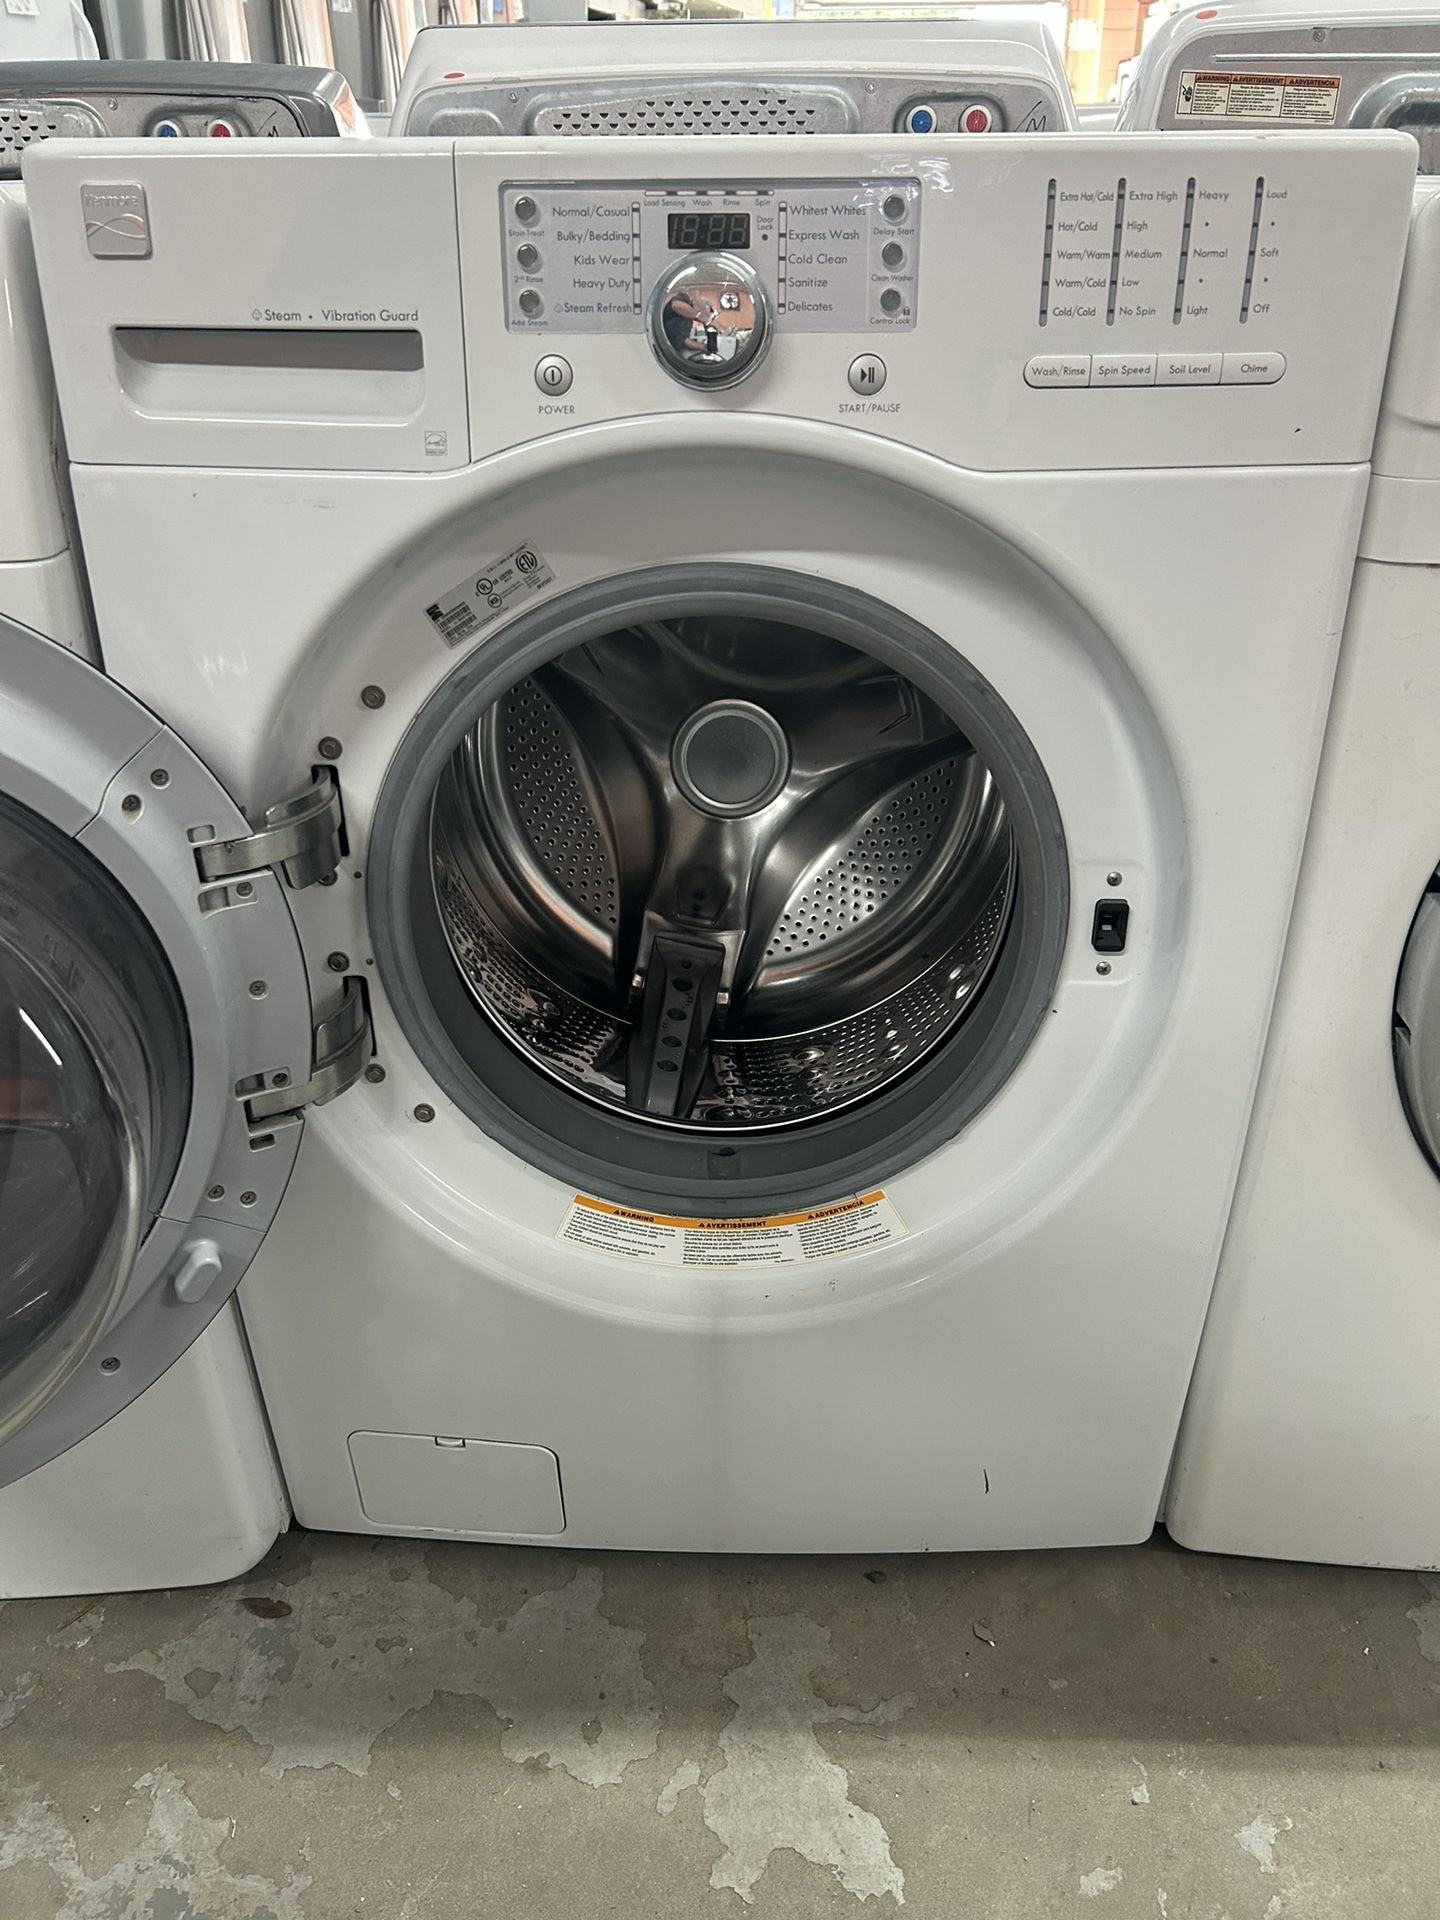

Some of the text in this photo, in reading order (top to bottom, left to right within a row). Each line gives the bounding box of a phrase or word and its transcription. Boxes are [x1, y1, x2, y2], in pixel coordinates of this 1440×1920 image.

[1060, 191, 1114, 202] Extra Hot/Cold
[1129, 191, 1178, 203] Extra High
[1199, 190, 1229, 202] Heavy
[1266, 190, 1288, 200] Loud
[644, 199, 685, 208] Load Sensing
[692, 199, 712, 207] Wash
[755, 199, 771, 208] Spin
[552, 205, 630, 218] Normal/Casual
[790, 206, 867, 216] Whitest Whites
[756, 216, 774, 224] Door
[757, 223, 774, 231] Lock
[1058, 222, 1098, 233] Hot/Cold
[1127, 221, 1148, 232] High
[508, 229, 545, 238] Stain Treat
[557, 229, 631, 243] Bulky/Bedding
[789, 230, 860, 242] Express Wash
[873, 227, 915, 237] Delay Start
[1057, 250, 1111, 261] Warm/Warm
[1124, 249, 1162, 259] Medium
[1193, 249, 1228, 259] Normal
[1260, 248, 1279, 258] Soft
[574, 255, 630, 265] Kids Wear
[788, 254, 848, 265] Cold Clean
[788, 278, 828, 288] Sanitize
[872, 274, 914, 282] Clean Washer
[1122, 278, 1140, 287] Low
[573, 279, 631, 291] Heavy Duty
[1055, 278, 1106, 289] Warm/Cold
[564, 303, 632, 314] Steam Refresh
[788, 302, 833, 312] Delicates
[1119, 306, 1156, 318] No Spin
[1186, 306, 1208, 317] Light
[1253, 304, 1271, 314] Off
[264, 309, 419, 322] Steam Vibration Guard
[1052, 307, 1097, 318] Cold/Cold
[527, 319, 548, 327] Steam
[870, 317, 910, 325] Control Lock
[1032, 366, 1086, 378] Wash/Rinse
[1098, 364, 1151, 377] Spin Speed
[1169, 364, 1211, 374] Soil Level
[1240, 363, 1268, 373] Chime
[538, 404, 576, 415] POWER
[838, 403, 901, 413] START/PAUSE
[815, 1200, 864, 1217] ADVERTENCIA
[620, 1210, 654, 1222] WARNING
